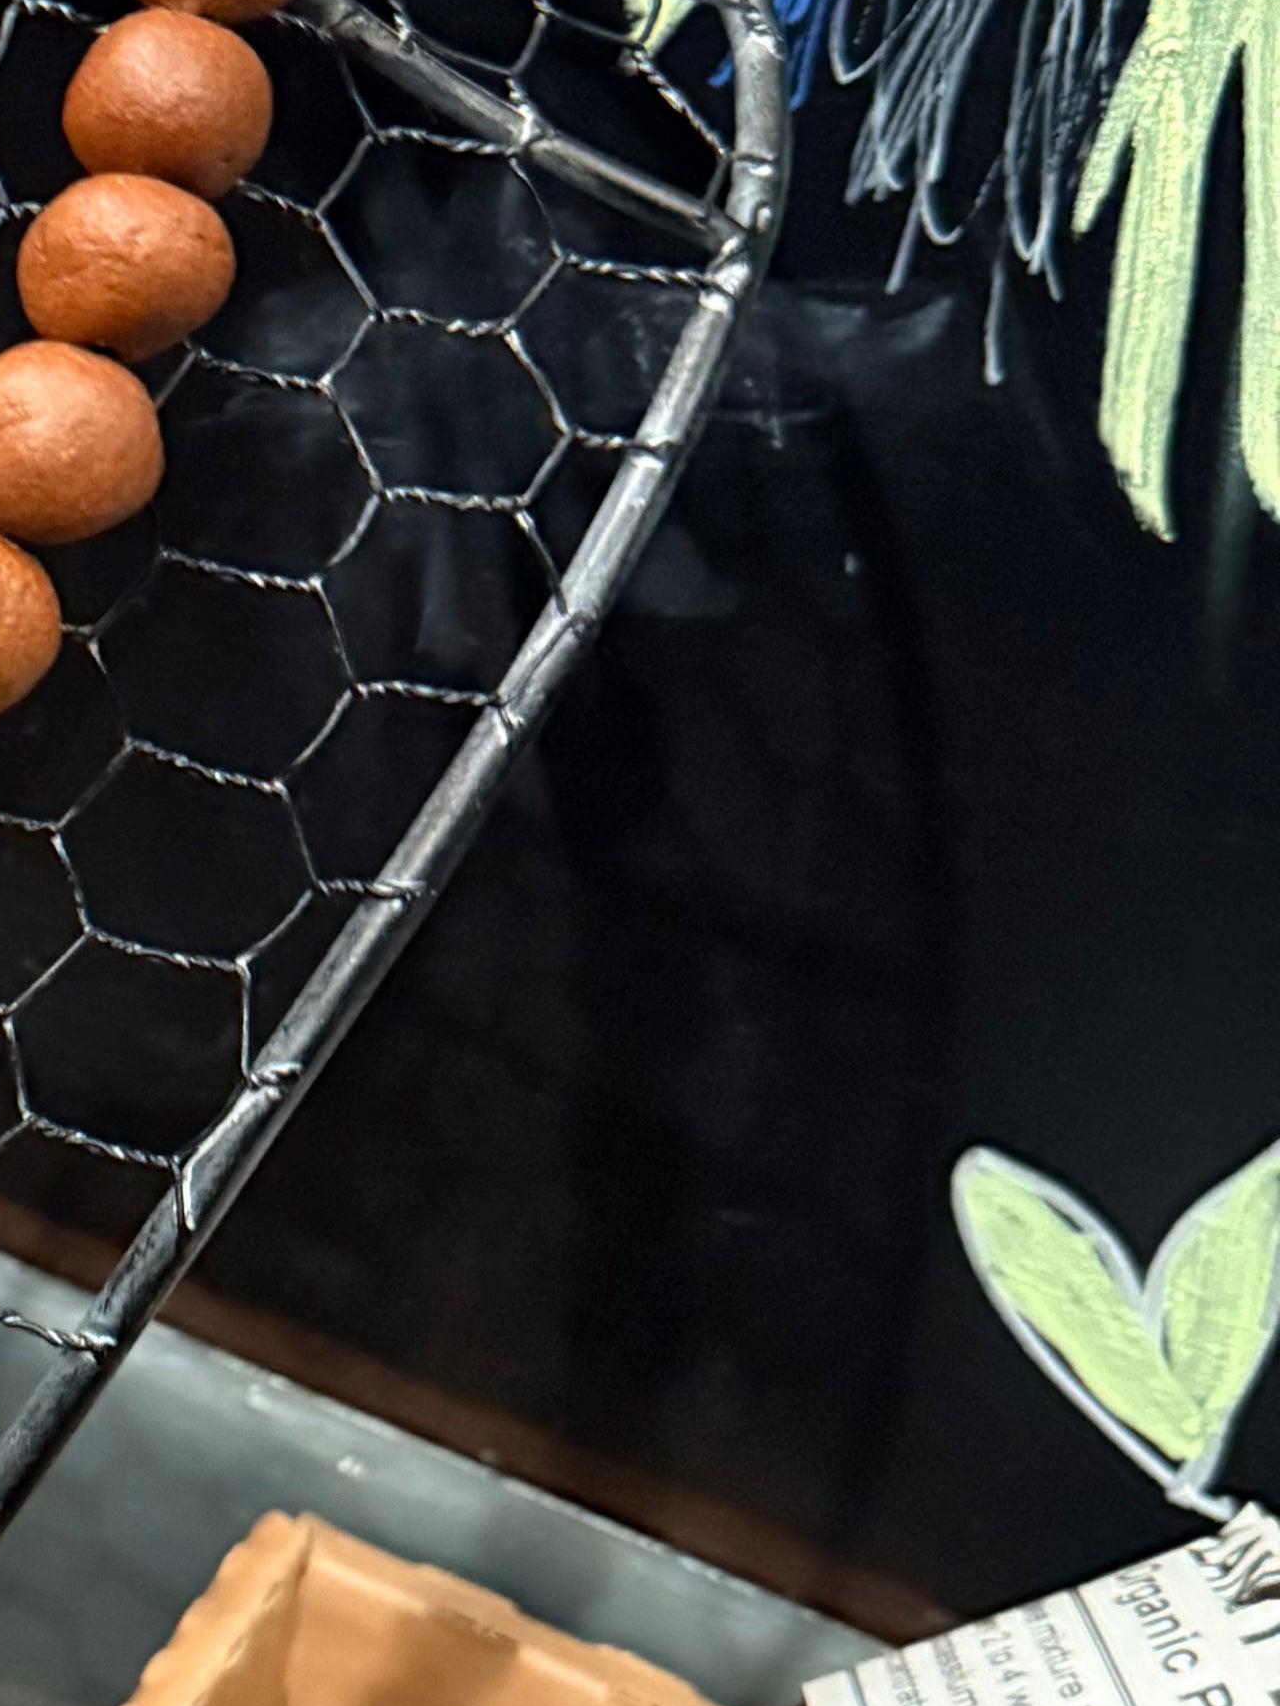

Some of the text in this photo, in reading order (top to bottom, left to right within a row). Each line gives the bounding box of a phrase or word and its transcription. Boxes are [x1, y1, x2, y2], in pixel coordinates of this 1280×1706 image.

[979, 1630, 1014, 1650] 2
[999, 1668, 1030, 1685] 4
[1036, 1622, 1086, 1701] mixture
